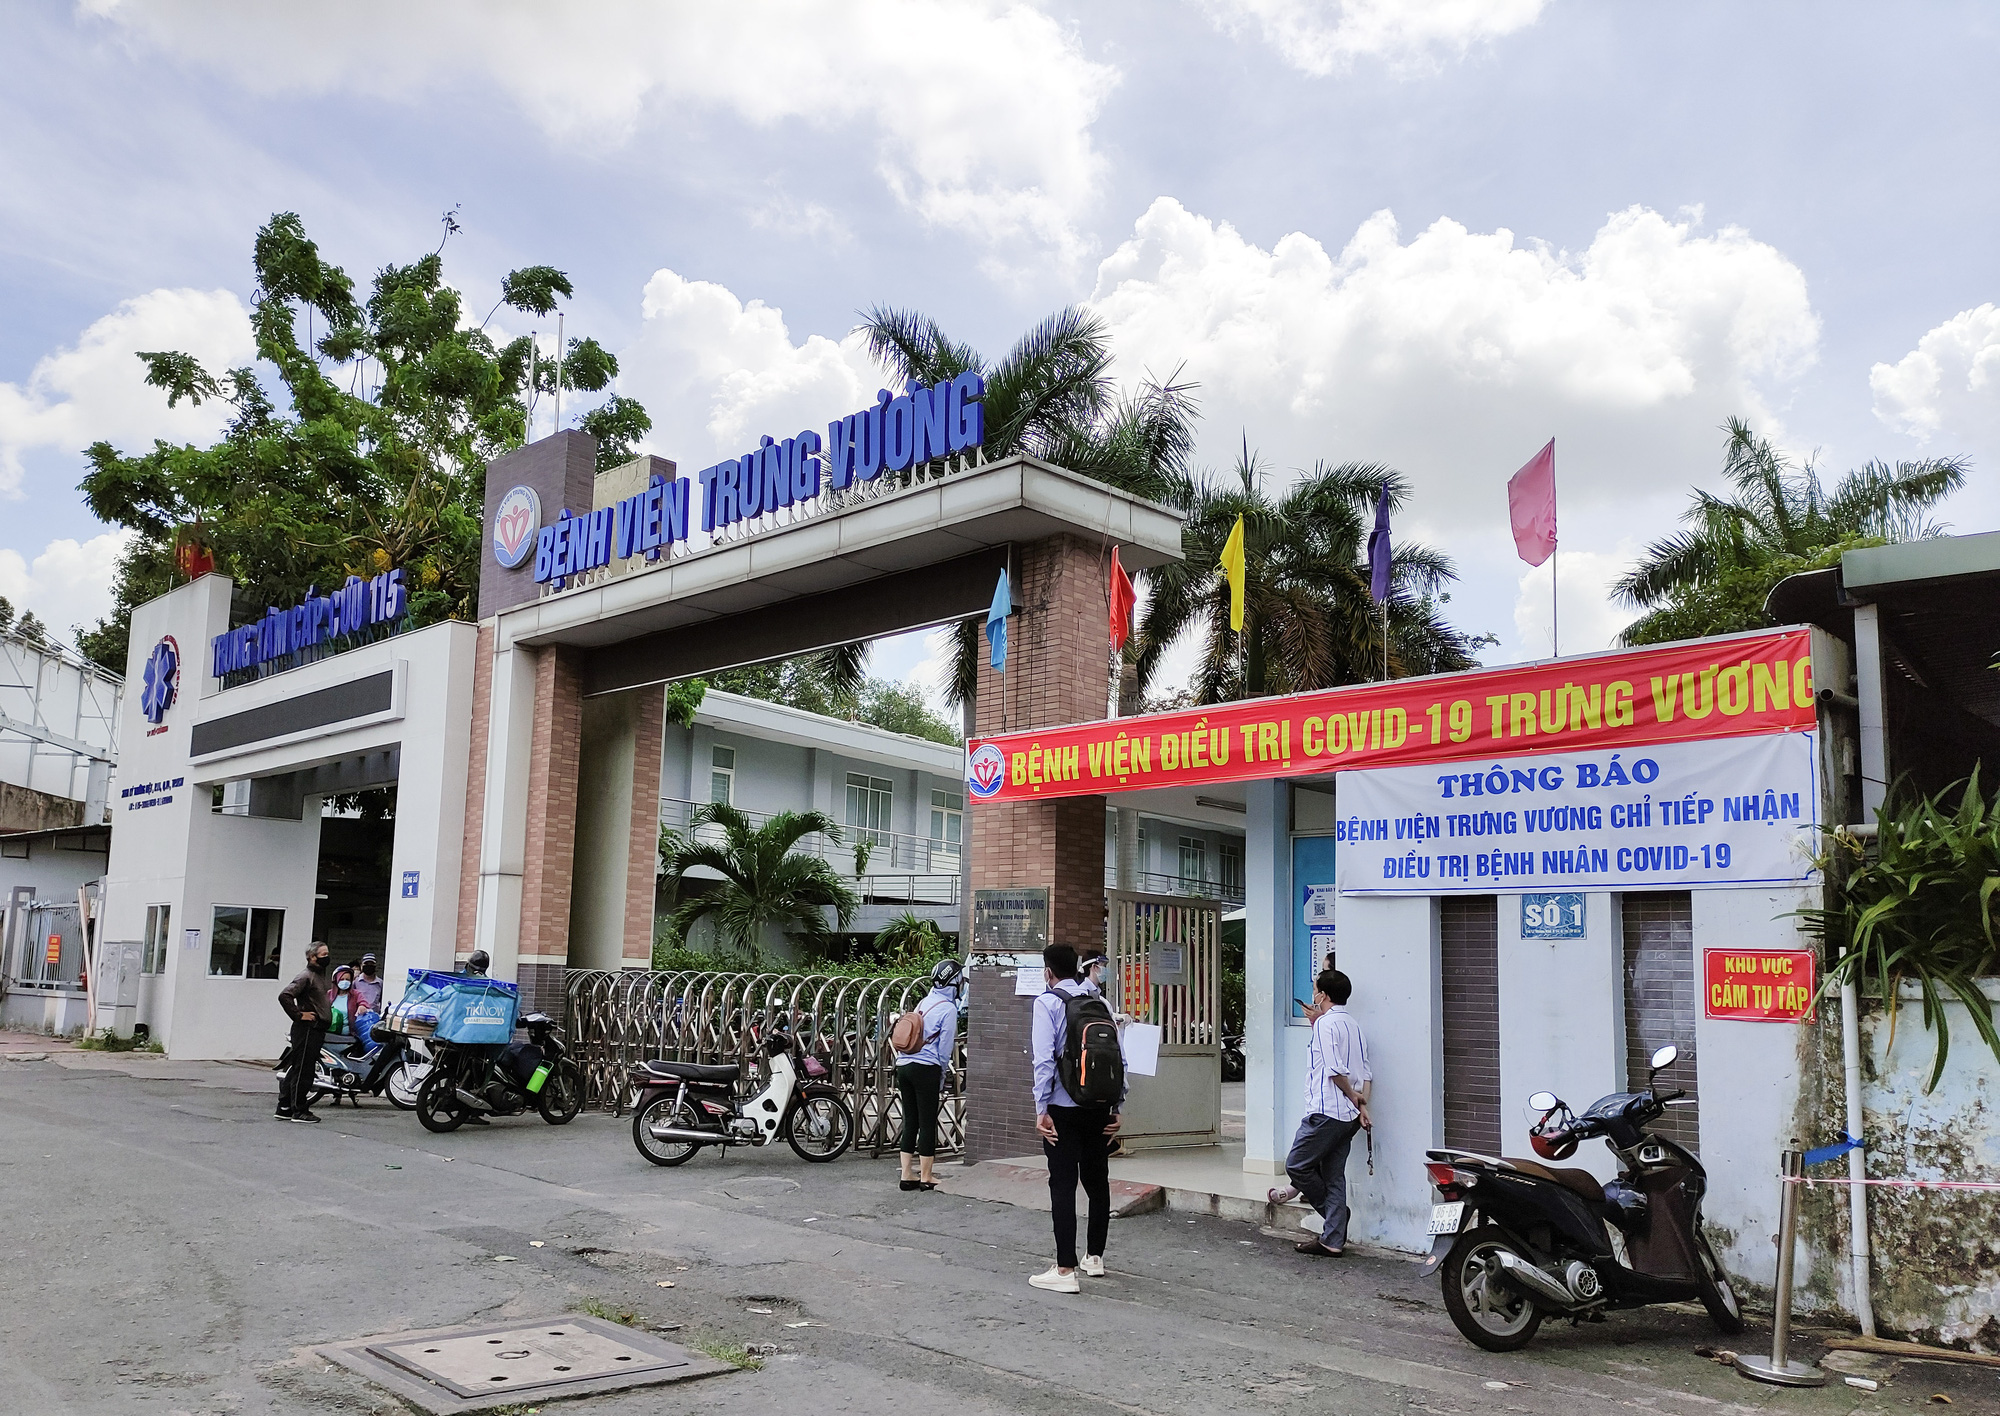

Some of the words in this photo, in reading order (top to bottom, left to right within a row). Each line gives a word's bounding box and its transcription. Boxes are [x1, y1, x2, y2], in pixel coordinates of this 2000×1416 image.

[534, 507, 613, 593] BỆNH
[617, 473, 690, 561] VIỆN
[699, 434, 822, 532] TRƯNG
[828, 370, 985, 490] VƯƠNG
[211, 624, 258, 678] TRUNG
[257, 606, 292, 662] TÂM
[291, 584, 331, 651] CẤP
[328, 575, 371, 638] CỨU
[370, 568, 407, 624] 115
[1012, 742, 1080, 792] BỆNH
[1087, 732, 1151, 784] VIỆN
[1160, 717, 1230, 771] ĐIỀU
[1240, 719, 1291, 769] TRỊ
[1302, 699, 1473, 757] COVID-19
[1486, 681, 1635, 739] TRƯNG
[1650, 656, 1815, 723] VƯƠNG
[1438, 765, 1565, 798] THÔNG
[1576, 753, 1660, 788] BÁO
[1337, 816, 1388, 846] BỆNH
[1395, 812, 1440, 844] VIỆN
[1446, 809, 1517, 837] TRƯNG
[1524, 804, 1602, 833] VƯƠNG
[1610, 794, 1652, 829] CHỈ
[1658, 790, 1714, 825] TIẾP
[1722, 789, 1800, 827] NHẬN
[1383, 849, 1431, 879] ĐIỀU
[1437, 854, 1469, 883] TRỊ
[1476, 847, 1535, 882] BỆNH
[1542, 845, 1608, 874] NHÂN
[1617, 843, 1732, 873] COVID-19
[407, 885, 414, 896] 1
[1525, 896, 1561, 927] SỐ
[1569, 904, 1582, 926] 1
[1725, 957, 1757, 974] KHU
[1761, 957, 1793, 978] VỰC
[1711, 976, 1748, 1009] CẤM
[1752, 985, 1772, 1015] TỤ
[1776, 981, 1809, 1016] TẬP
